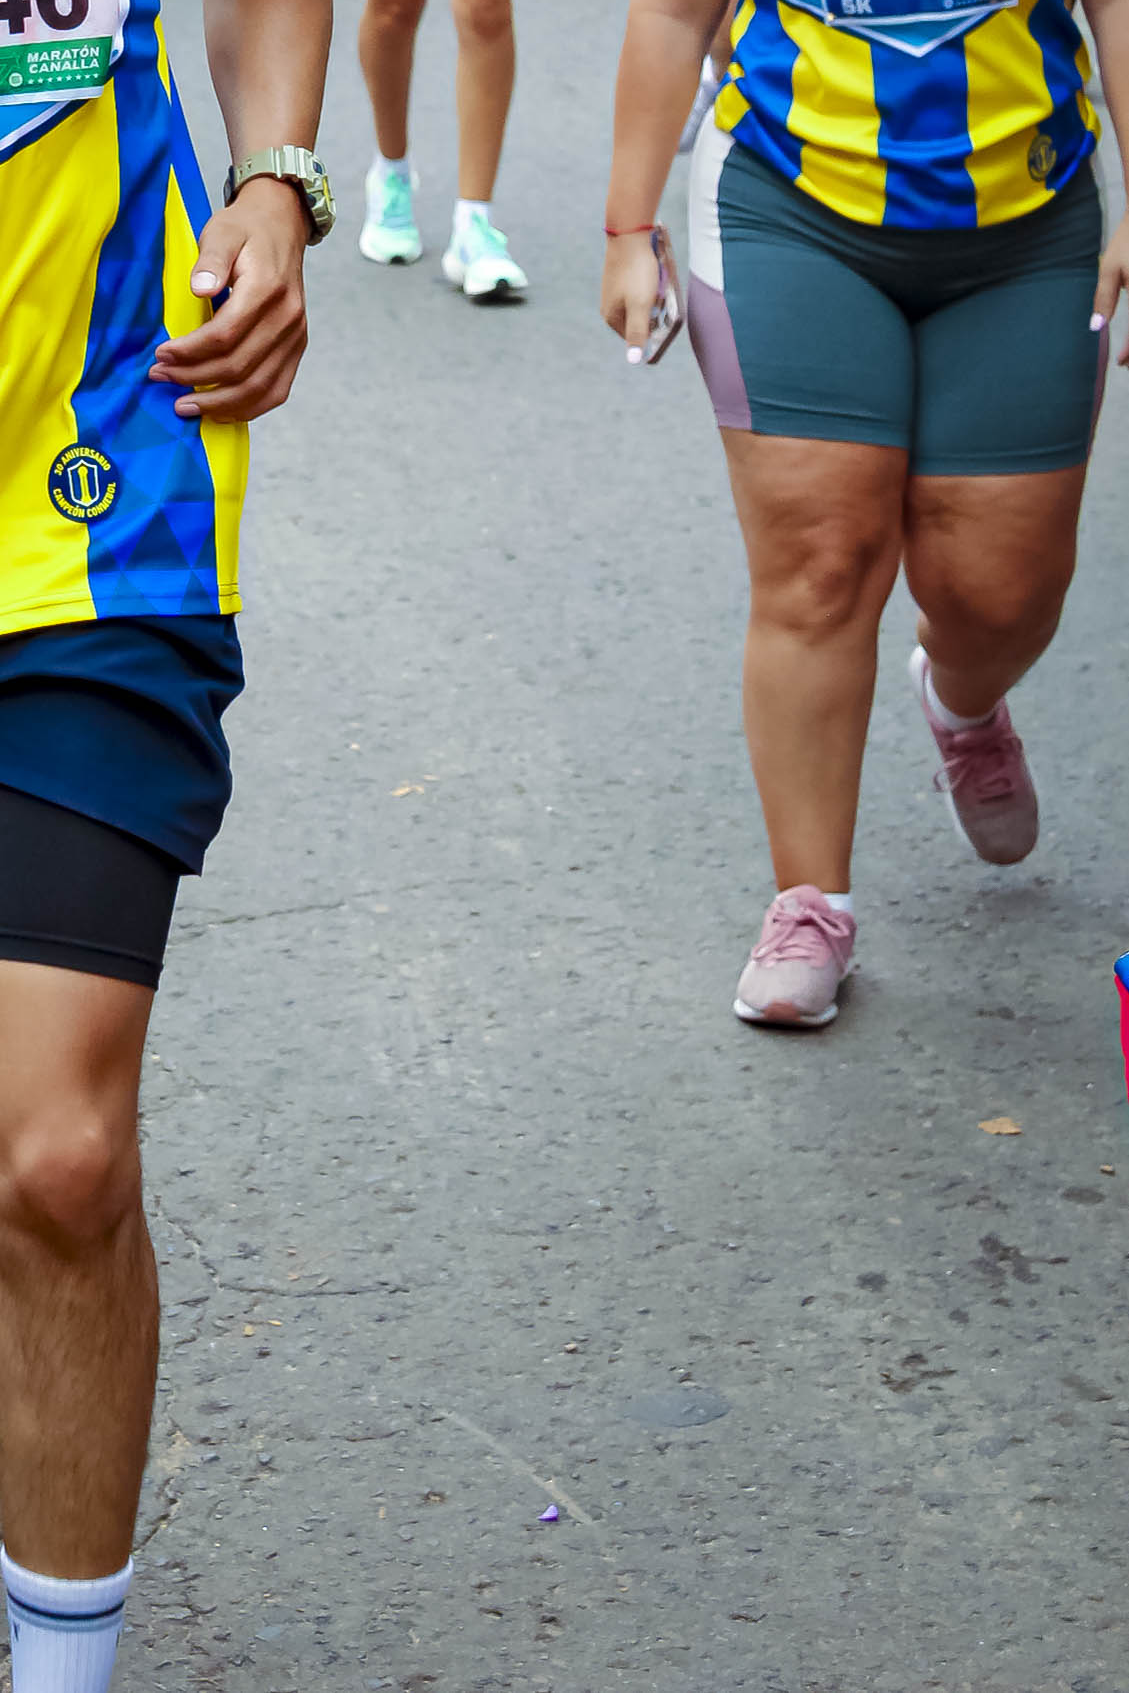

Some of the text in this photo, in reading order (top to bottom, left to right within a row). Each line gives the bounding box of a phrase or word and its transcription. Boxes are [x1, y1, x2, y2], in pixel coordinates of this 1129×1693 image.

[27, 44, 100, 63] MARATÓN
[28, 58, 100, 74] CANALLA
[62, 448, 111, 470] ANIVERSARIO
[53, 483, 116, 518] CAMPEÓN CONMEBOL
